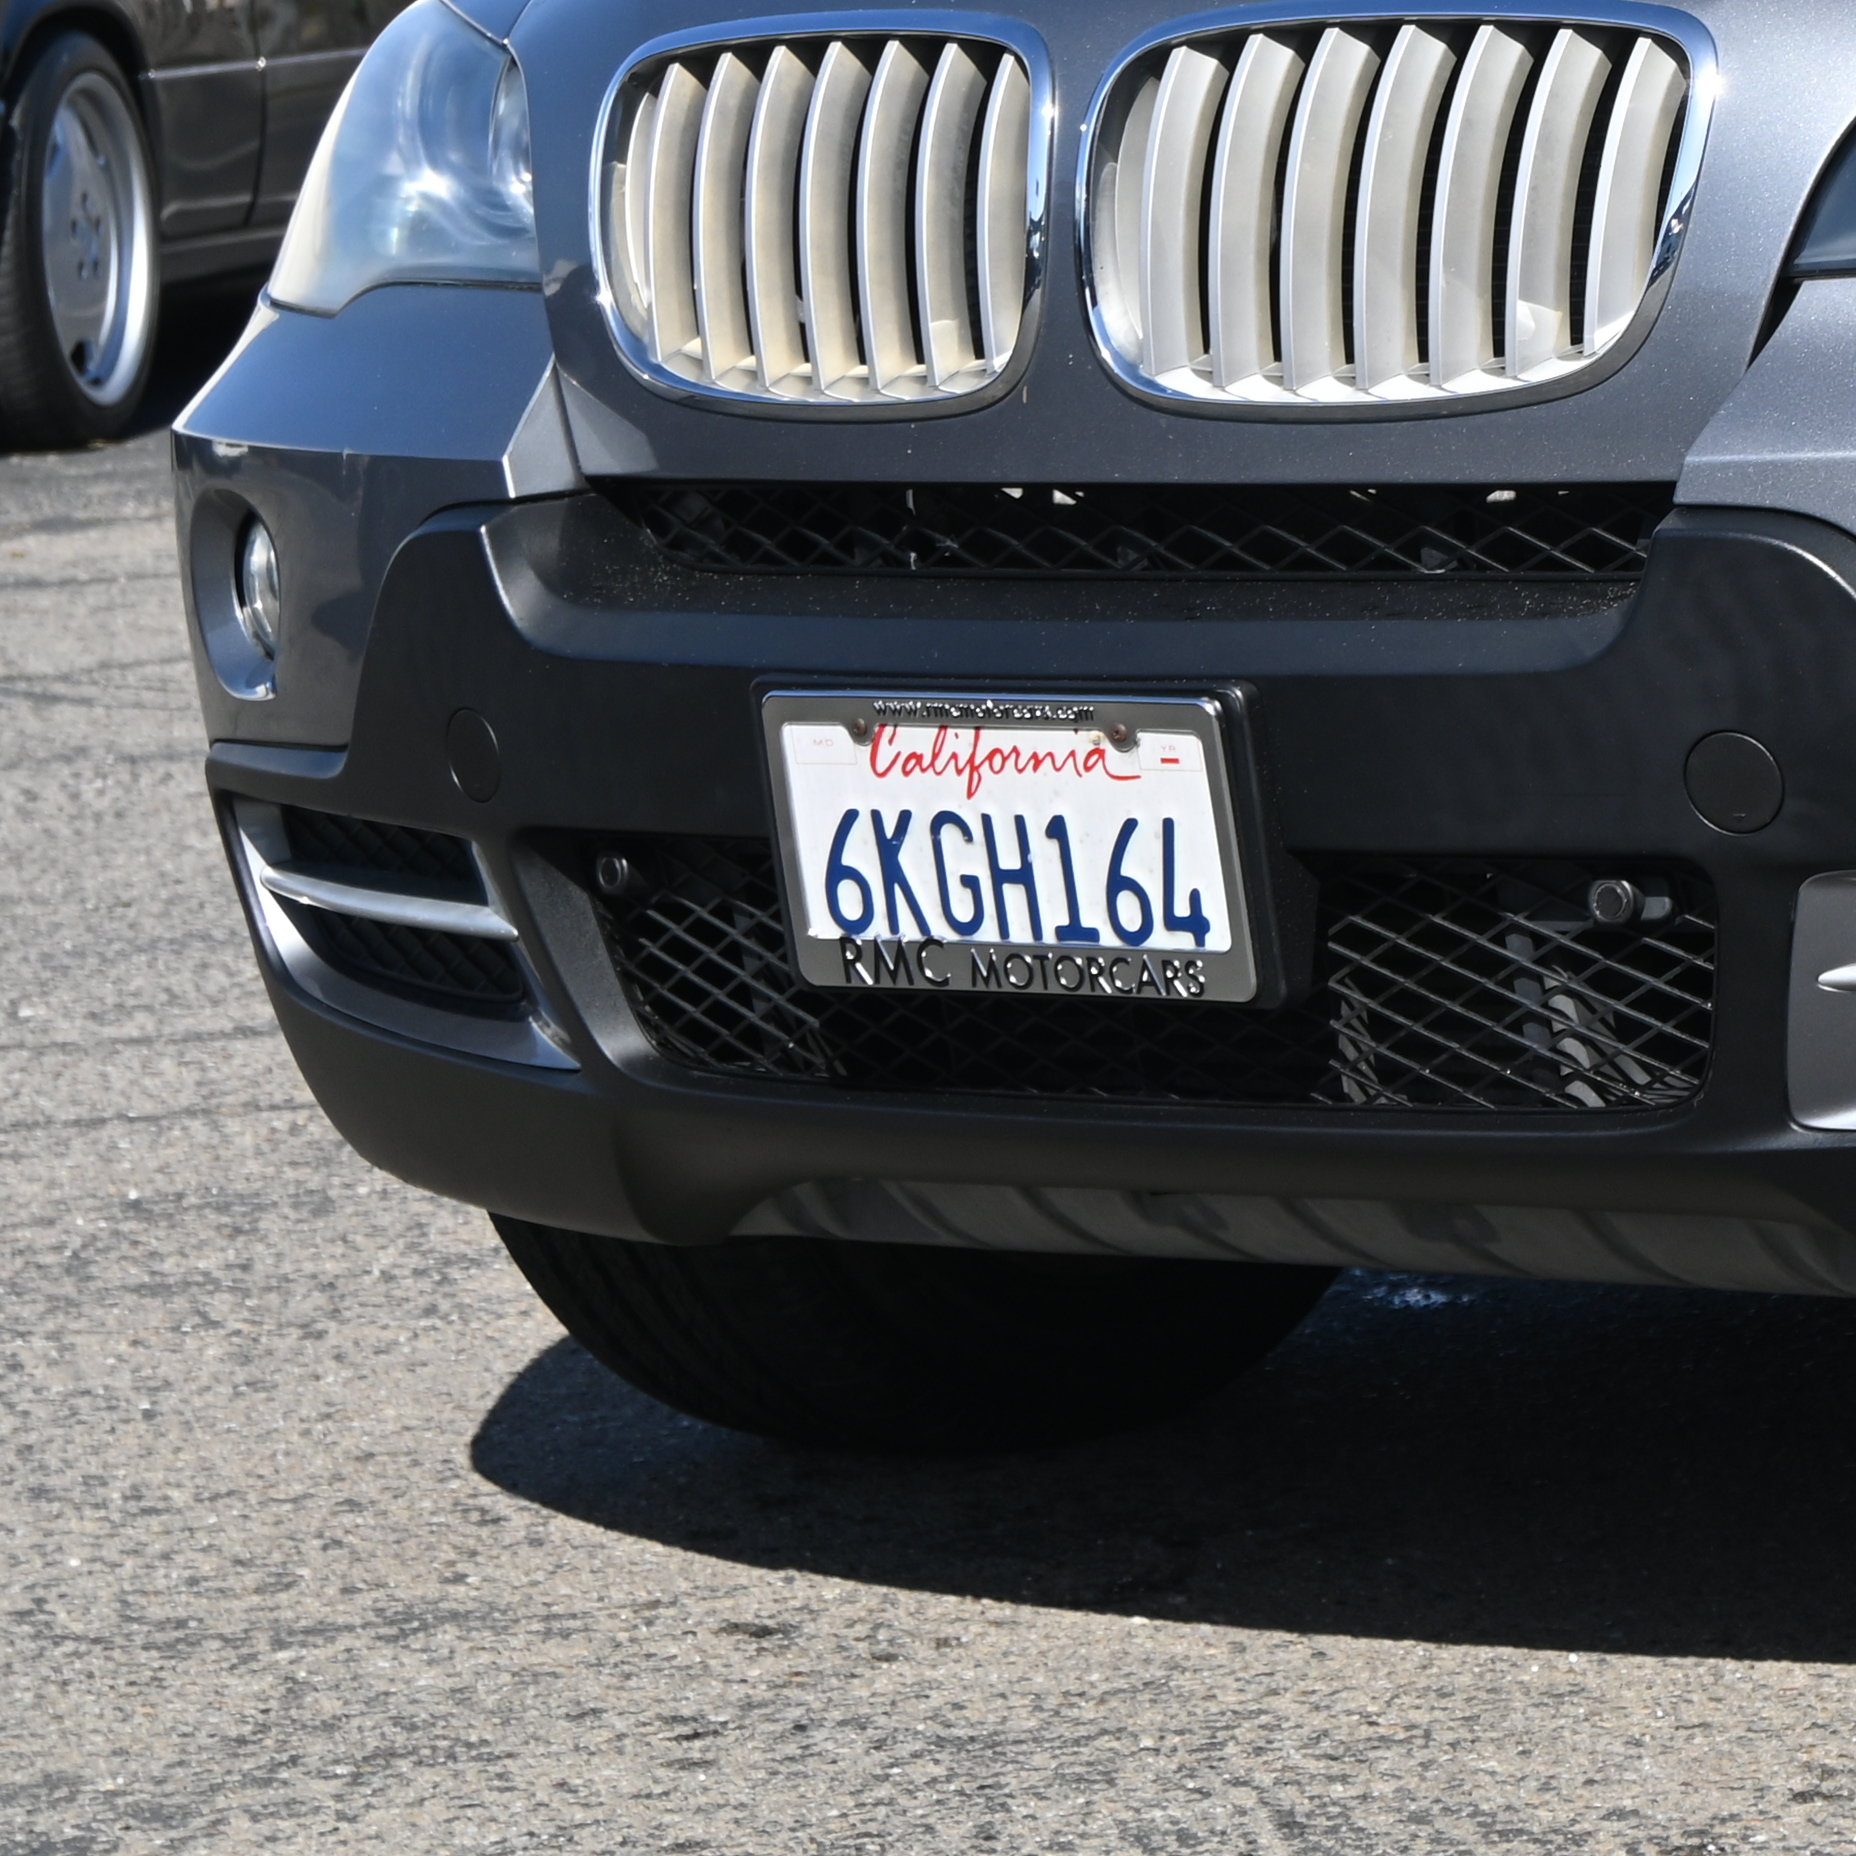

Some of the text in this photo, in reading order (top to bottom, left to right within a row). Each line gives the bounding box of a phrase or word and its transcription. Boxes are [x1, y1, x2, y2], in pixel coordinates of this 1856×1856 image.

[869, 723, 1142, 800] California
[825, 808, 1211, 947] 6KGH164
[840, 936, 1207, 998] RMC MOTORCARS
